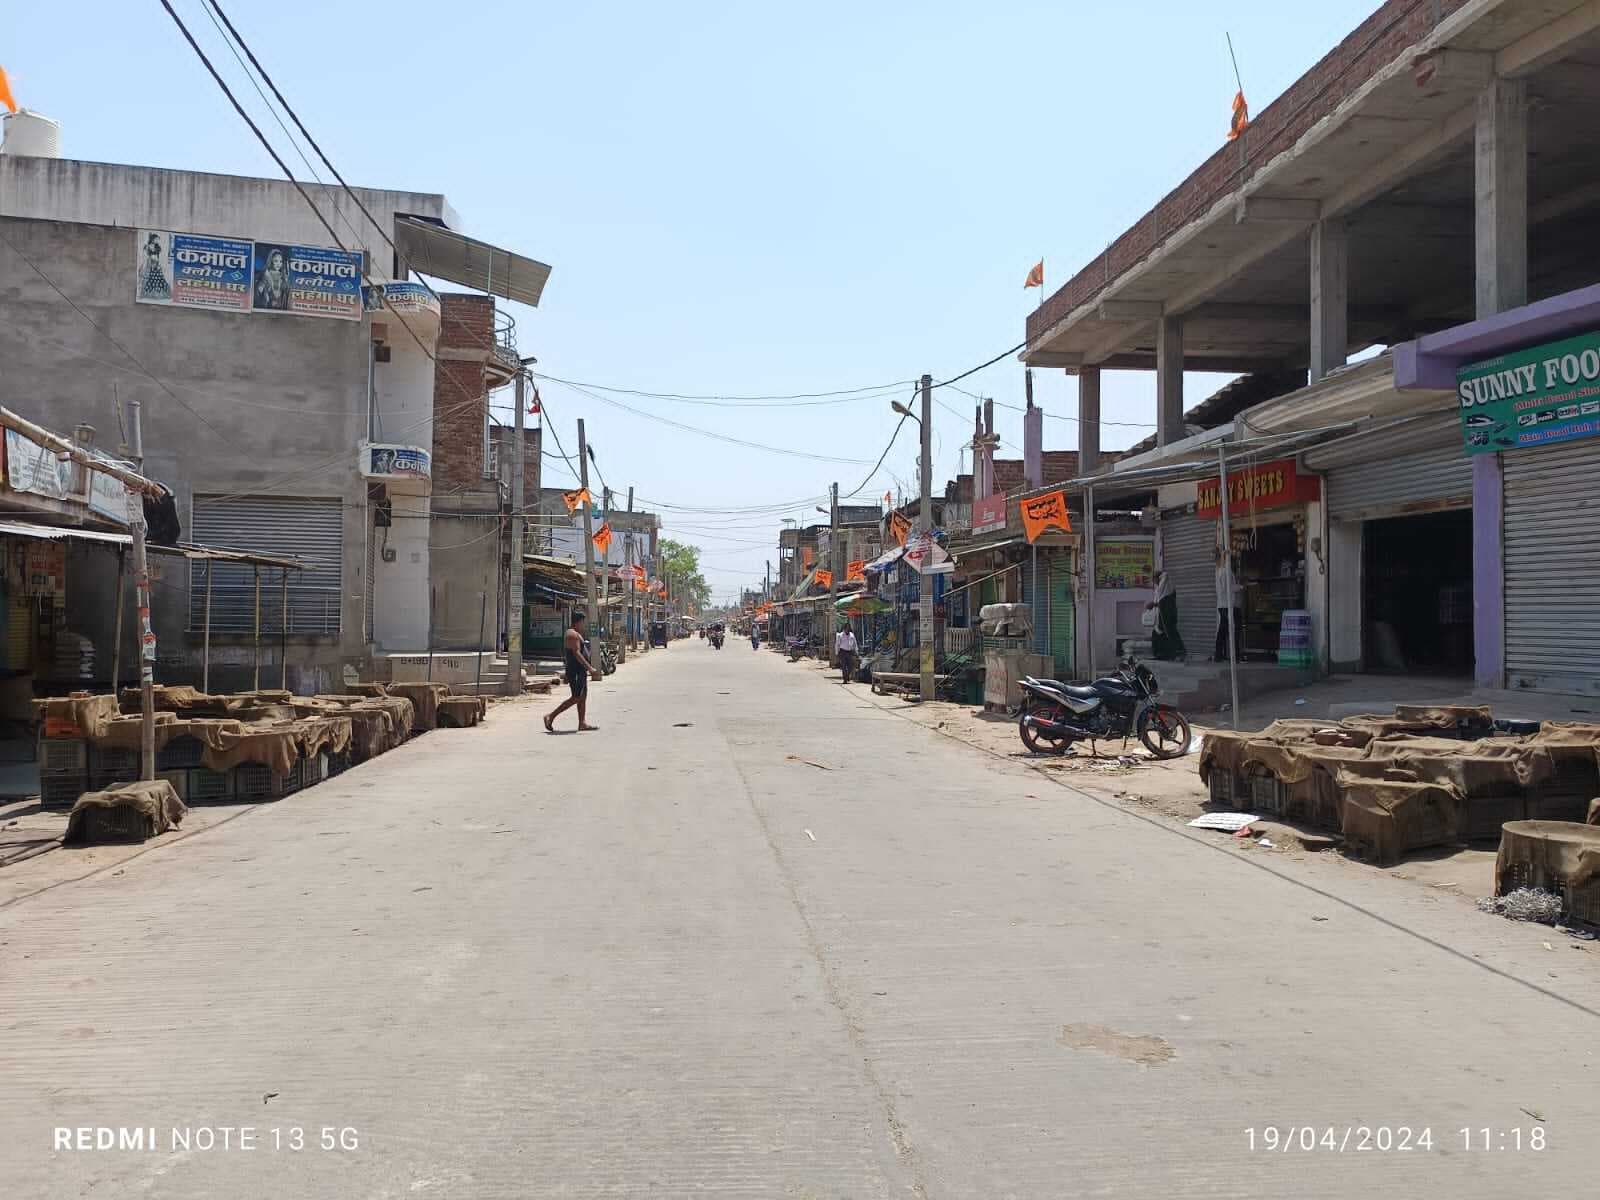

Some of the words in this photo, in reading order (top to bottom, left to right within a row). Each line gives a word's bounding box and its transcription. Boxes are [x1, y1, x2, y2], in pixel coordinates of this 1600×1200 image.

[176, 248, 248, 269] कमाल
[290, 258, 356, 278] कमाल
[1459, 363, 1537, 408] SUNNY
[1542, 347, 1600, 389] FOO
[1238, 470, 1283, 501] SWEETS
